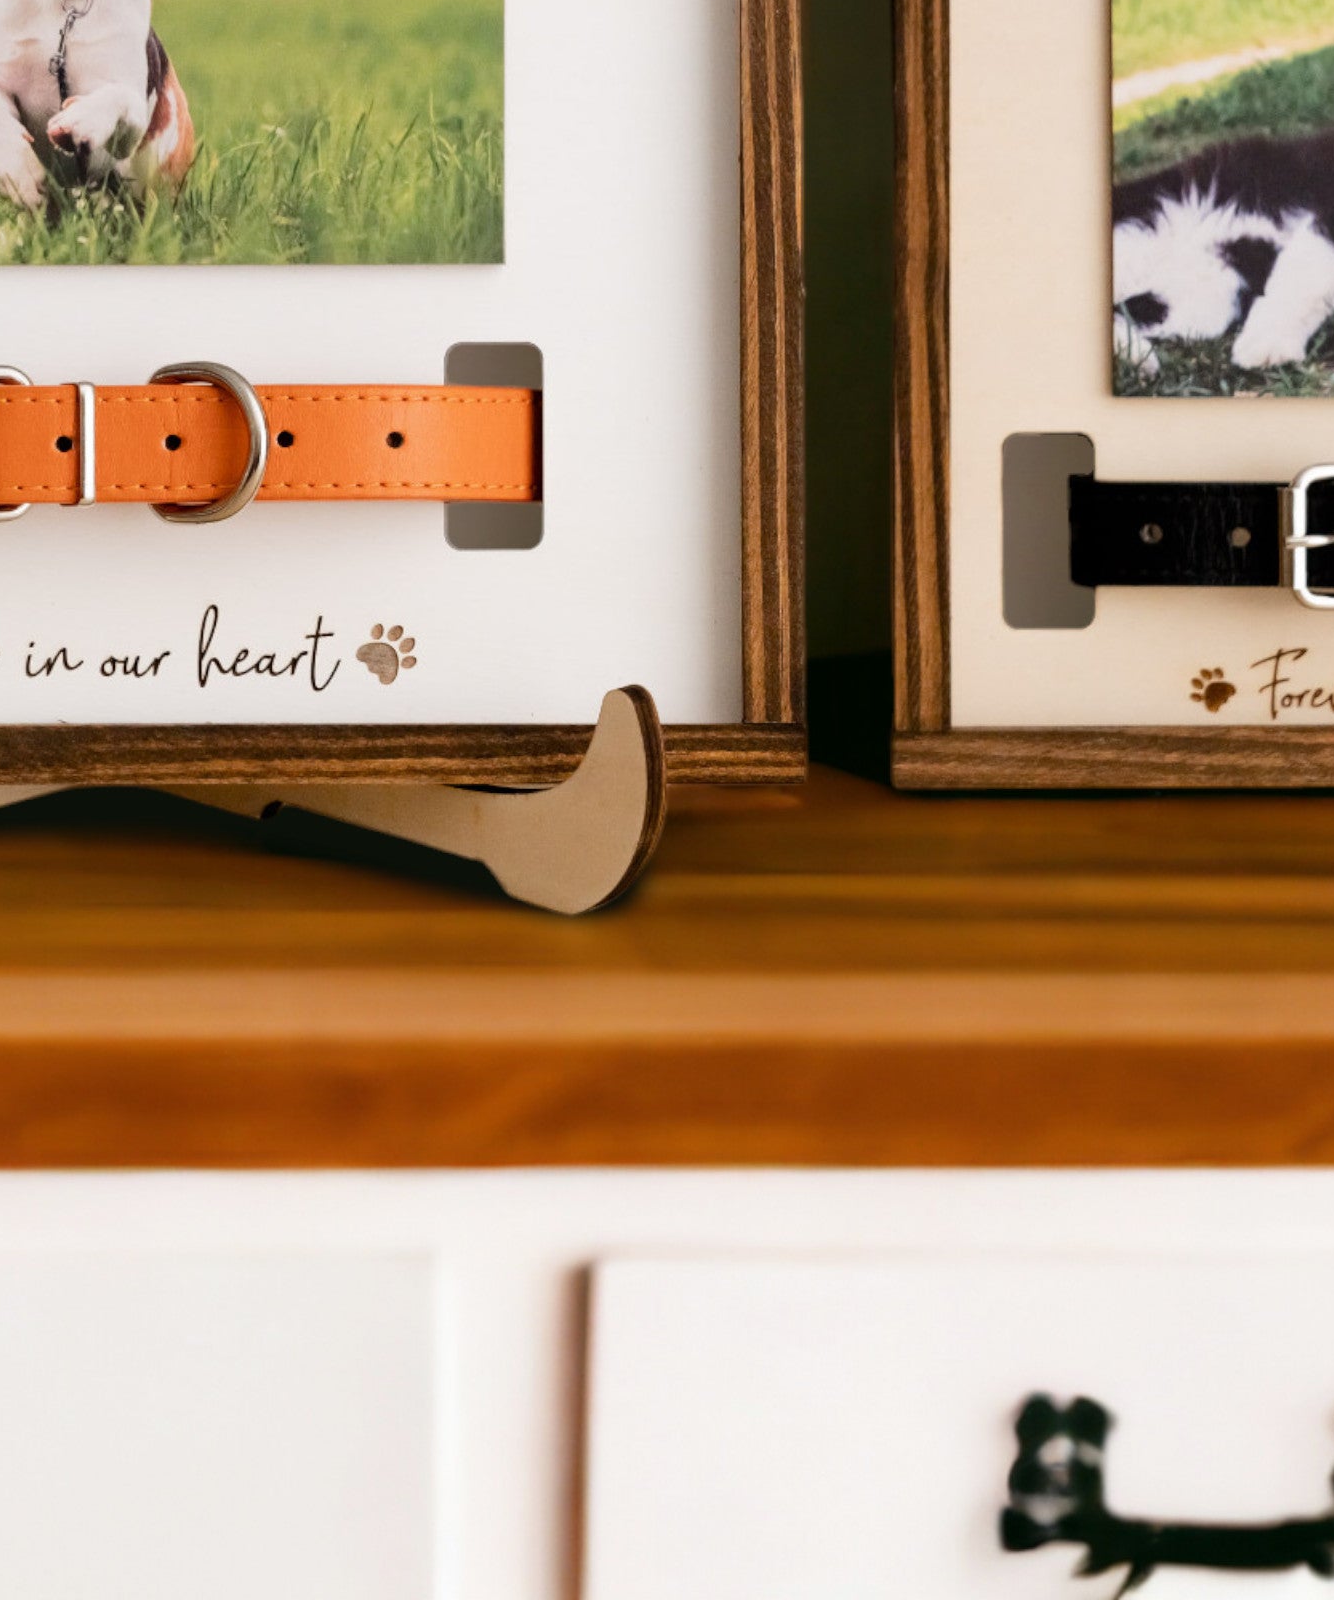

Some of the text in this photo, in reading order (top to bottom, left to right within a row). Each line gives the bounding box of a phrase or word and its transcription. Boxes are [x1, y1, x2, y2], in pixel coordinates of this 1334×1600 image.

[24, 640, 84, 678] in
[98, 649, 172, 679] our
[196, 604, 341, 693] heart
